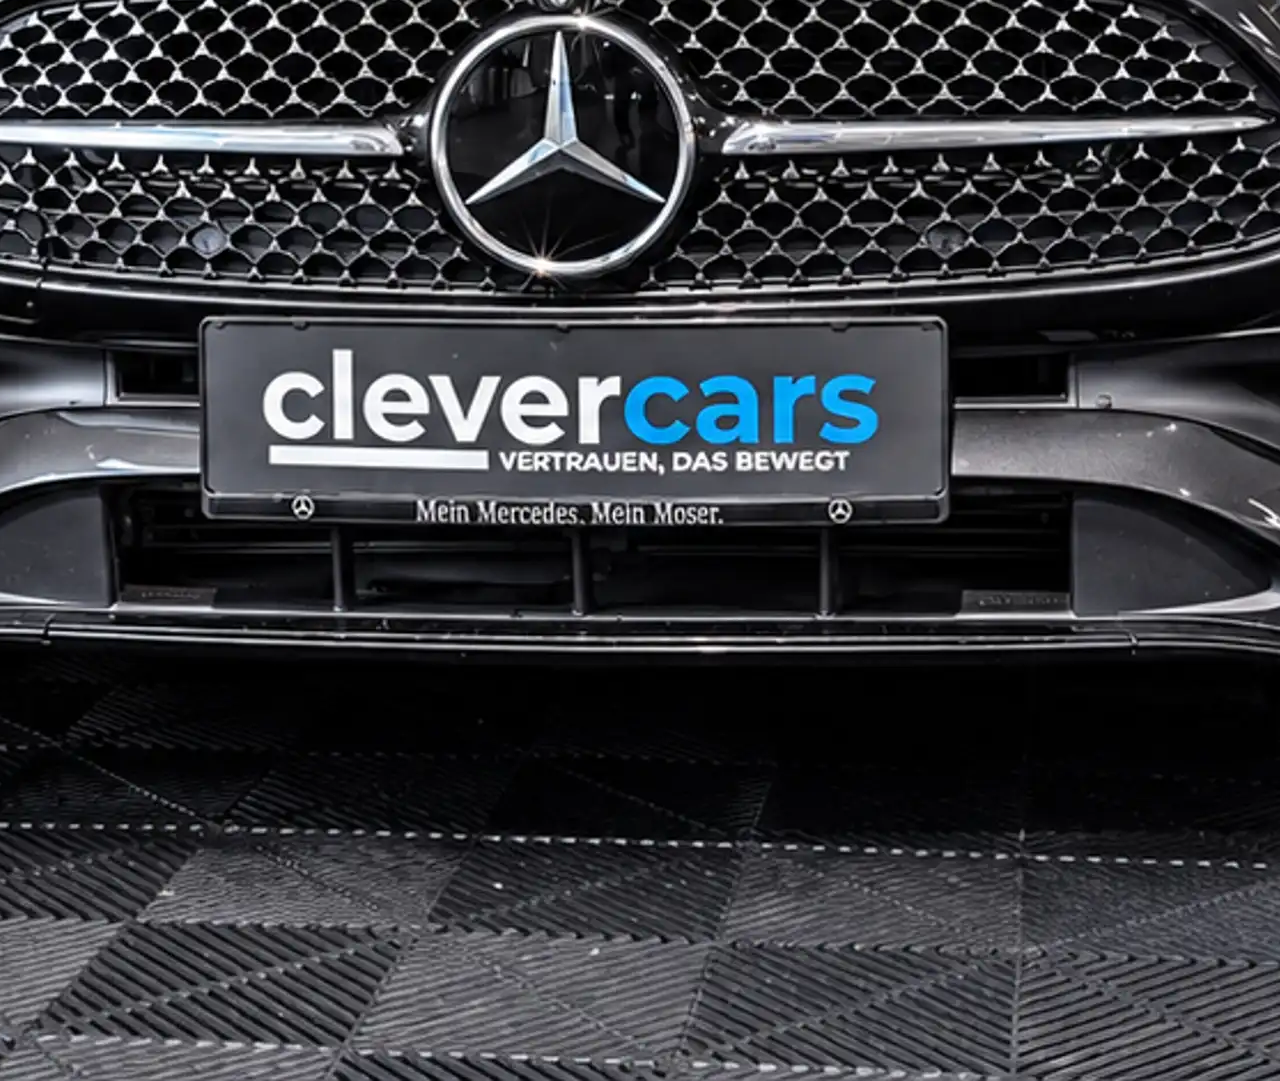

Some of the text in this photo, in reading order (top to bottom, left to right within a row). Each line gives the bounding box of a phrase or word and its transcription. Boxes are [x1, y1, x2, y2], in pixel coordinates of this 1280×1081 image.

[262, 348, 877, 445] clevercars
[498, 450, 851, 476] VERTRAUEN, DAS BEWEGT
[416, 499, 725, 525] Mein Mercedes. Mein Moser.
